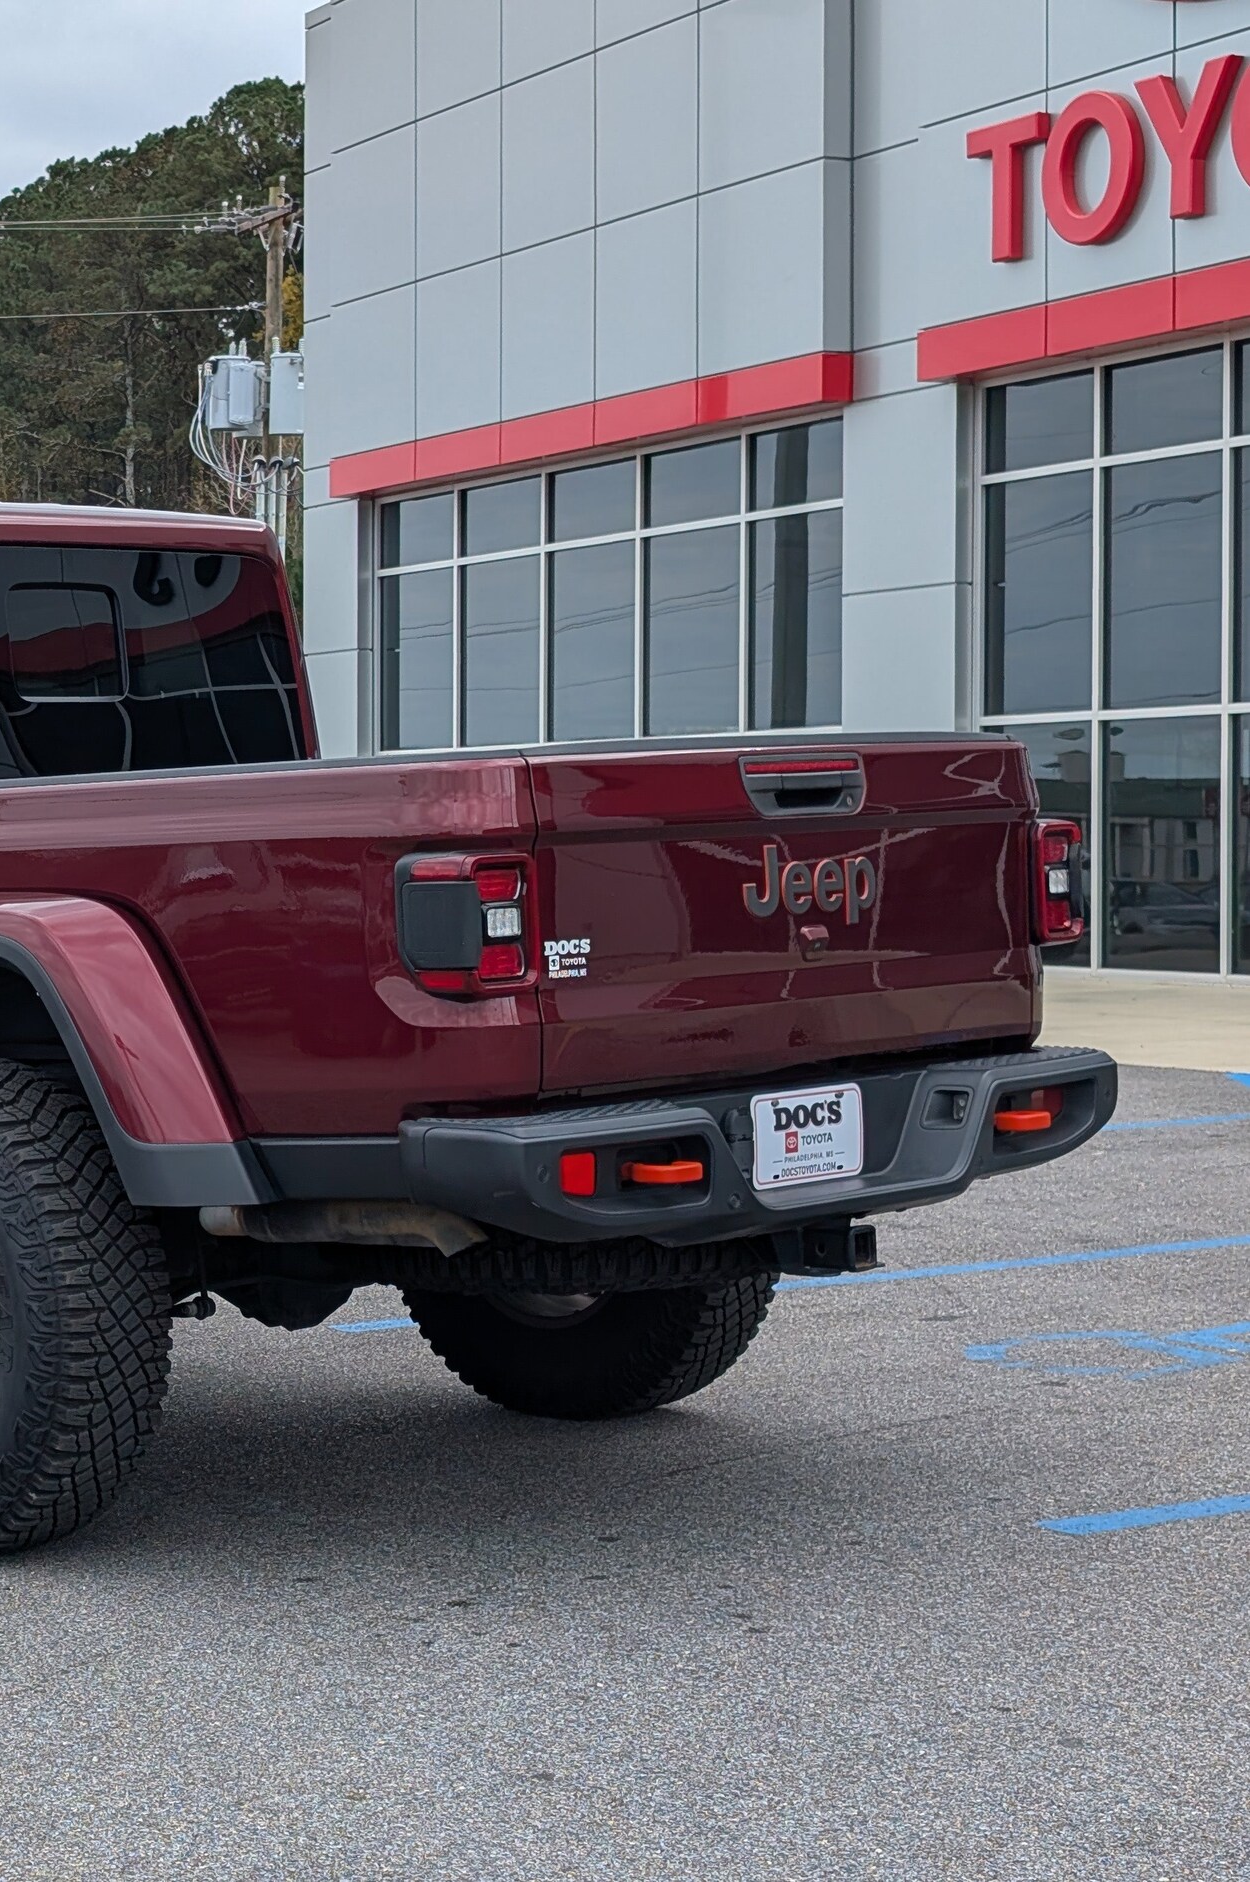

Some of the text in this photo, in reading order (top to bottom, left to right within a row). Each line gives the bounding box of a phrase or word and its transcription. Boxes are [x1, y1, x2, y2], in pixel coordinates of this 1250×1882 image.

[965, 54, 1250, 263] TOY
[742, 844, 876, 925] Jeep
[560, 957, 587, 967] TOYOTA
[772, 1099, 843, 1132] DOC'S
[801, 1132, 834, 1146] TOYOTA
[781, 1161, 837, 1178] DOCSTOYOTA.COM
